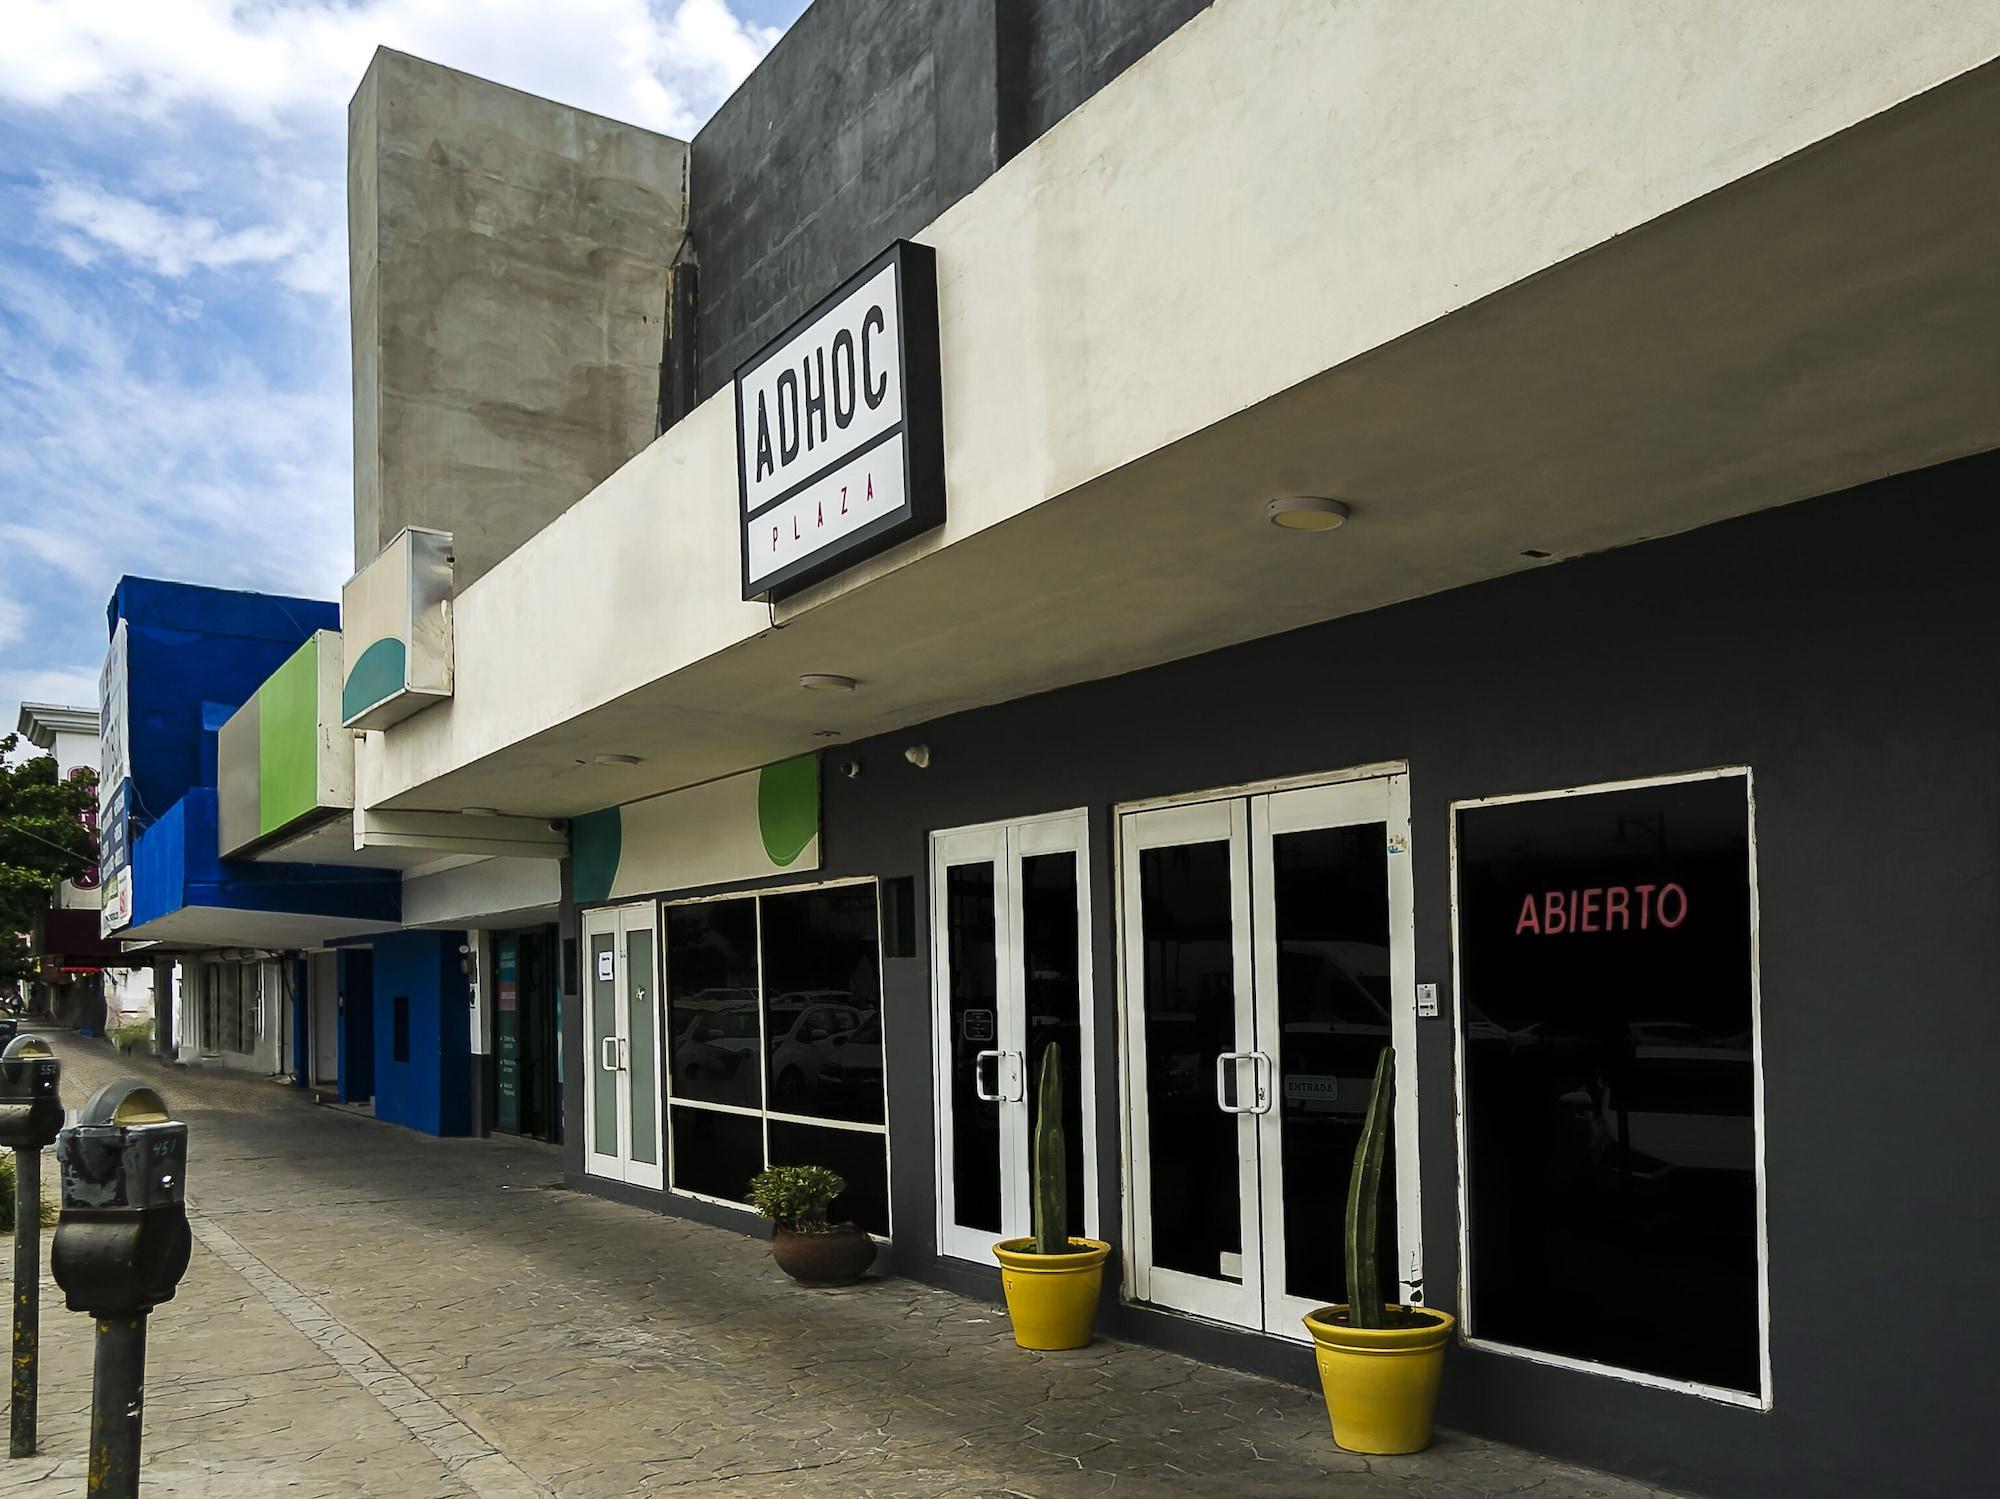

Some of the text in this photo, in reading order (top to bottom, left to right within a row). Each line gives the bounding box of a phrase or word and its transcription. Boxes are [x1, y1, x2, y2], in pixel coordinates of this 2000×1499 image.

[756, 304, 889, 483] ADHOC
[771, 473, 875, 552] PLAZA
[1515, 882, 1689, 935] ABIERTO
[1288, 1081, 1334, 1093] ENTRADA
